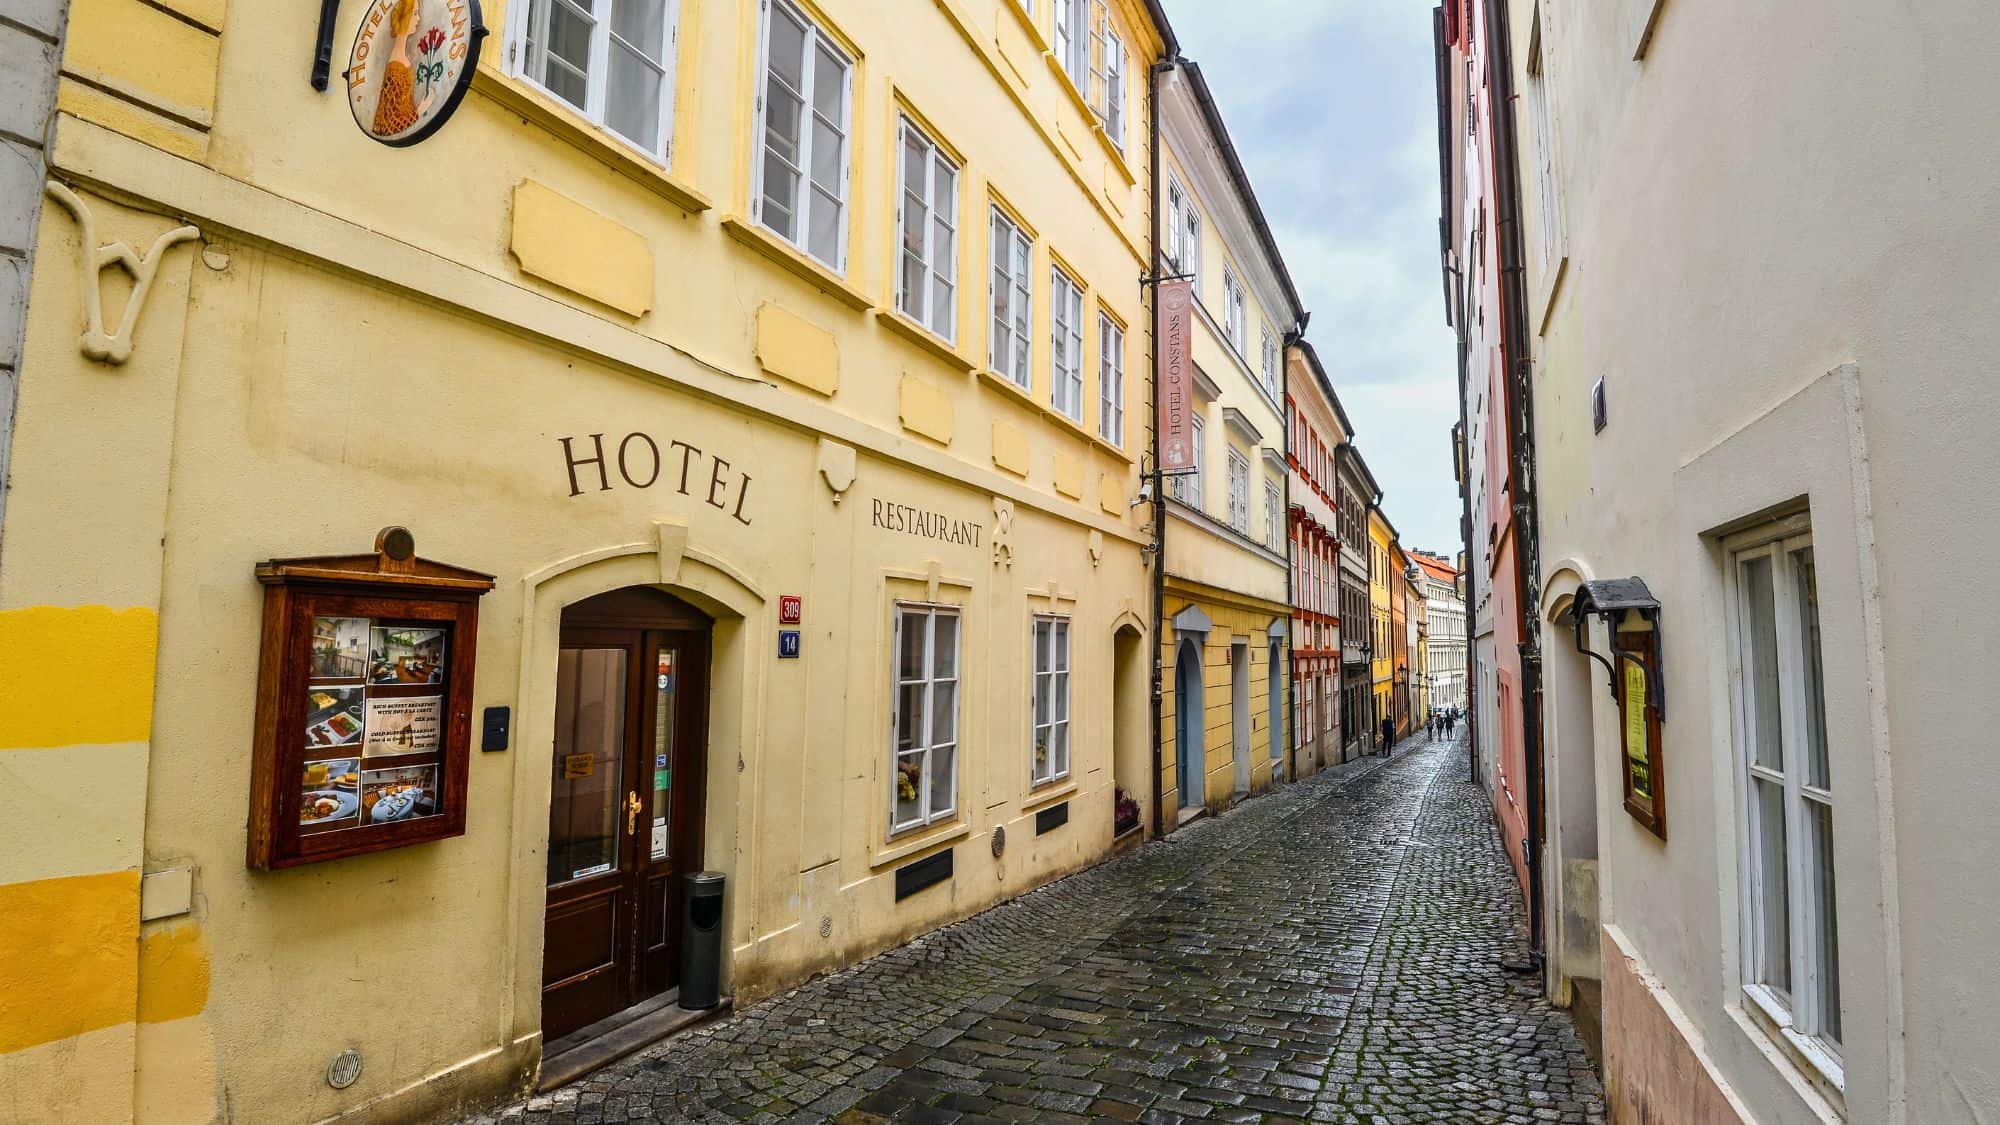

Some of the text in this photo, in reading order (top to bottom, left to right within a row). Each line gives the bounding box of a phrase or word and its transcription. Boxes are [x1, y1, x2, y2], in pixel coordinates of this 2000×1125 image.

[350, 0, 393, 89] HOTEL
[1169, 314, 1181, 435] HOTEL CONSTANS
[558, 432, 753, 526] HOTEL
[872, 498, 983, 548] RESTAURANT
[784, 601, 799, 618] 309
[785, 636, 796, 653] 14
